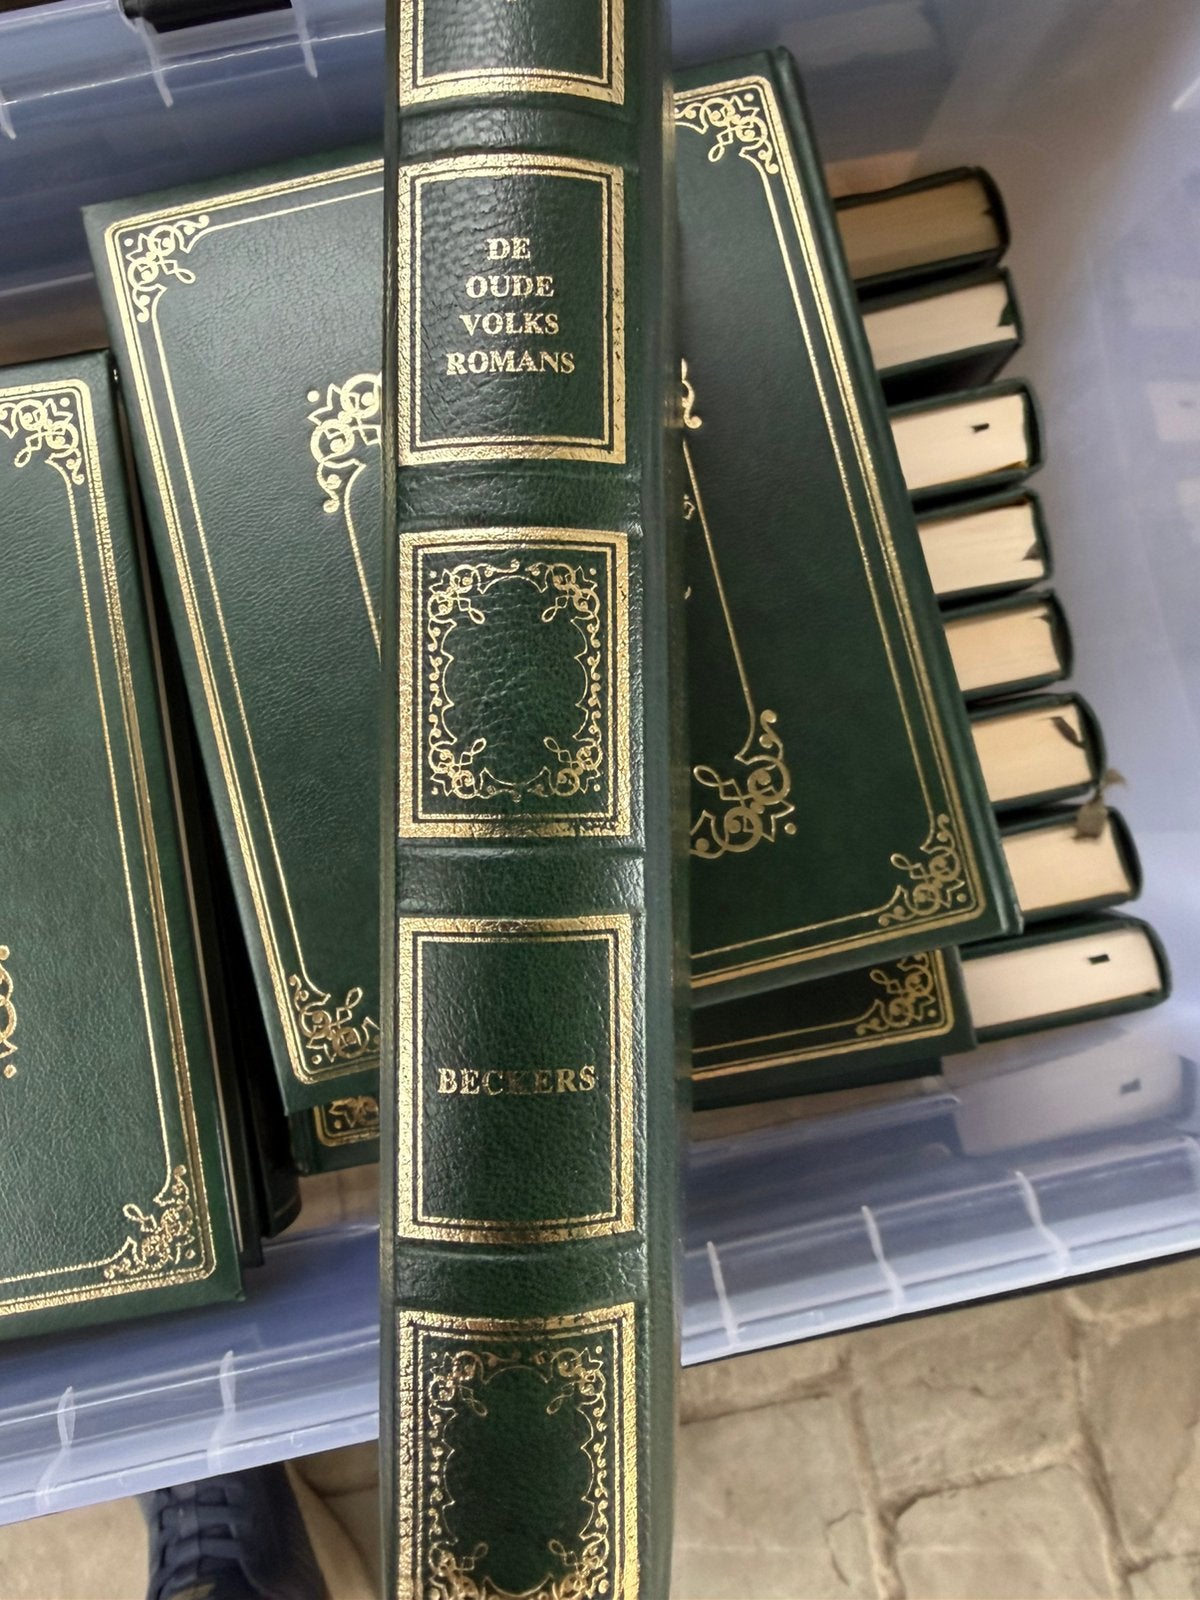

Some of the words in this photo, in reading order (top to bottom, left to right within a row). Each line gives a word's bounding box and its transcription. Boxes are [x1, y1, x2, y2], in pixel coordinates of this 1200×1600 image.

[486, 237, 531, 260] DE
[465, 274, 554, 298] OUDE
[459, 312, 560, 336] VOLKS
[446, 350, 575, 376] ROMANS
[437, 1064, 596, 1095] BECKERS
